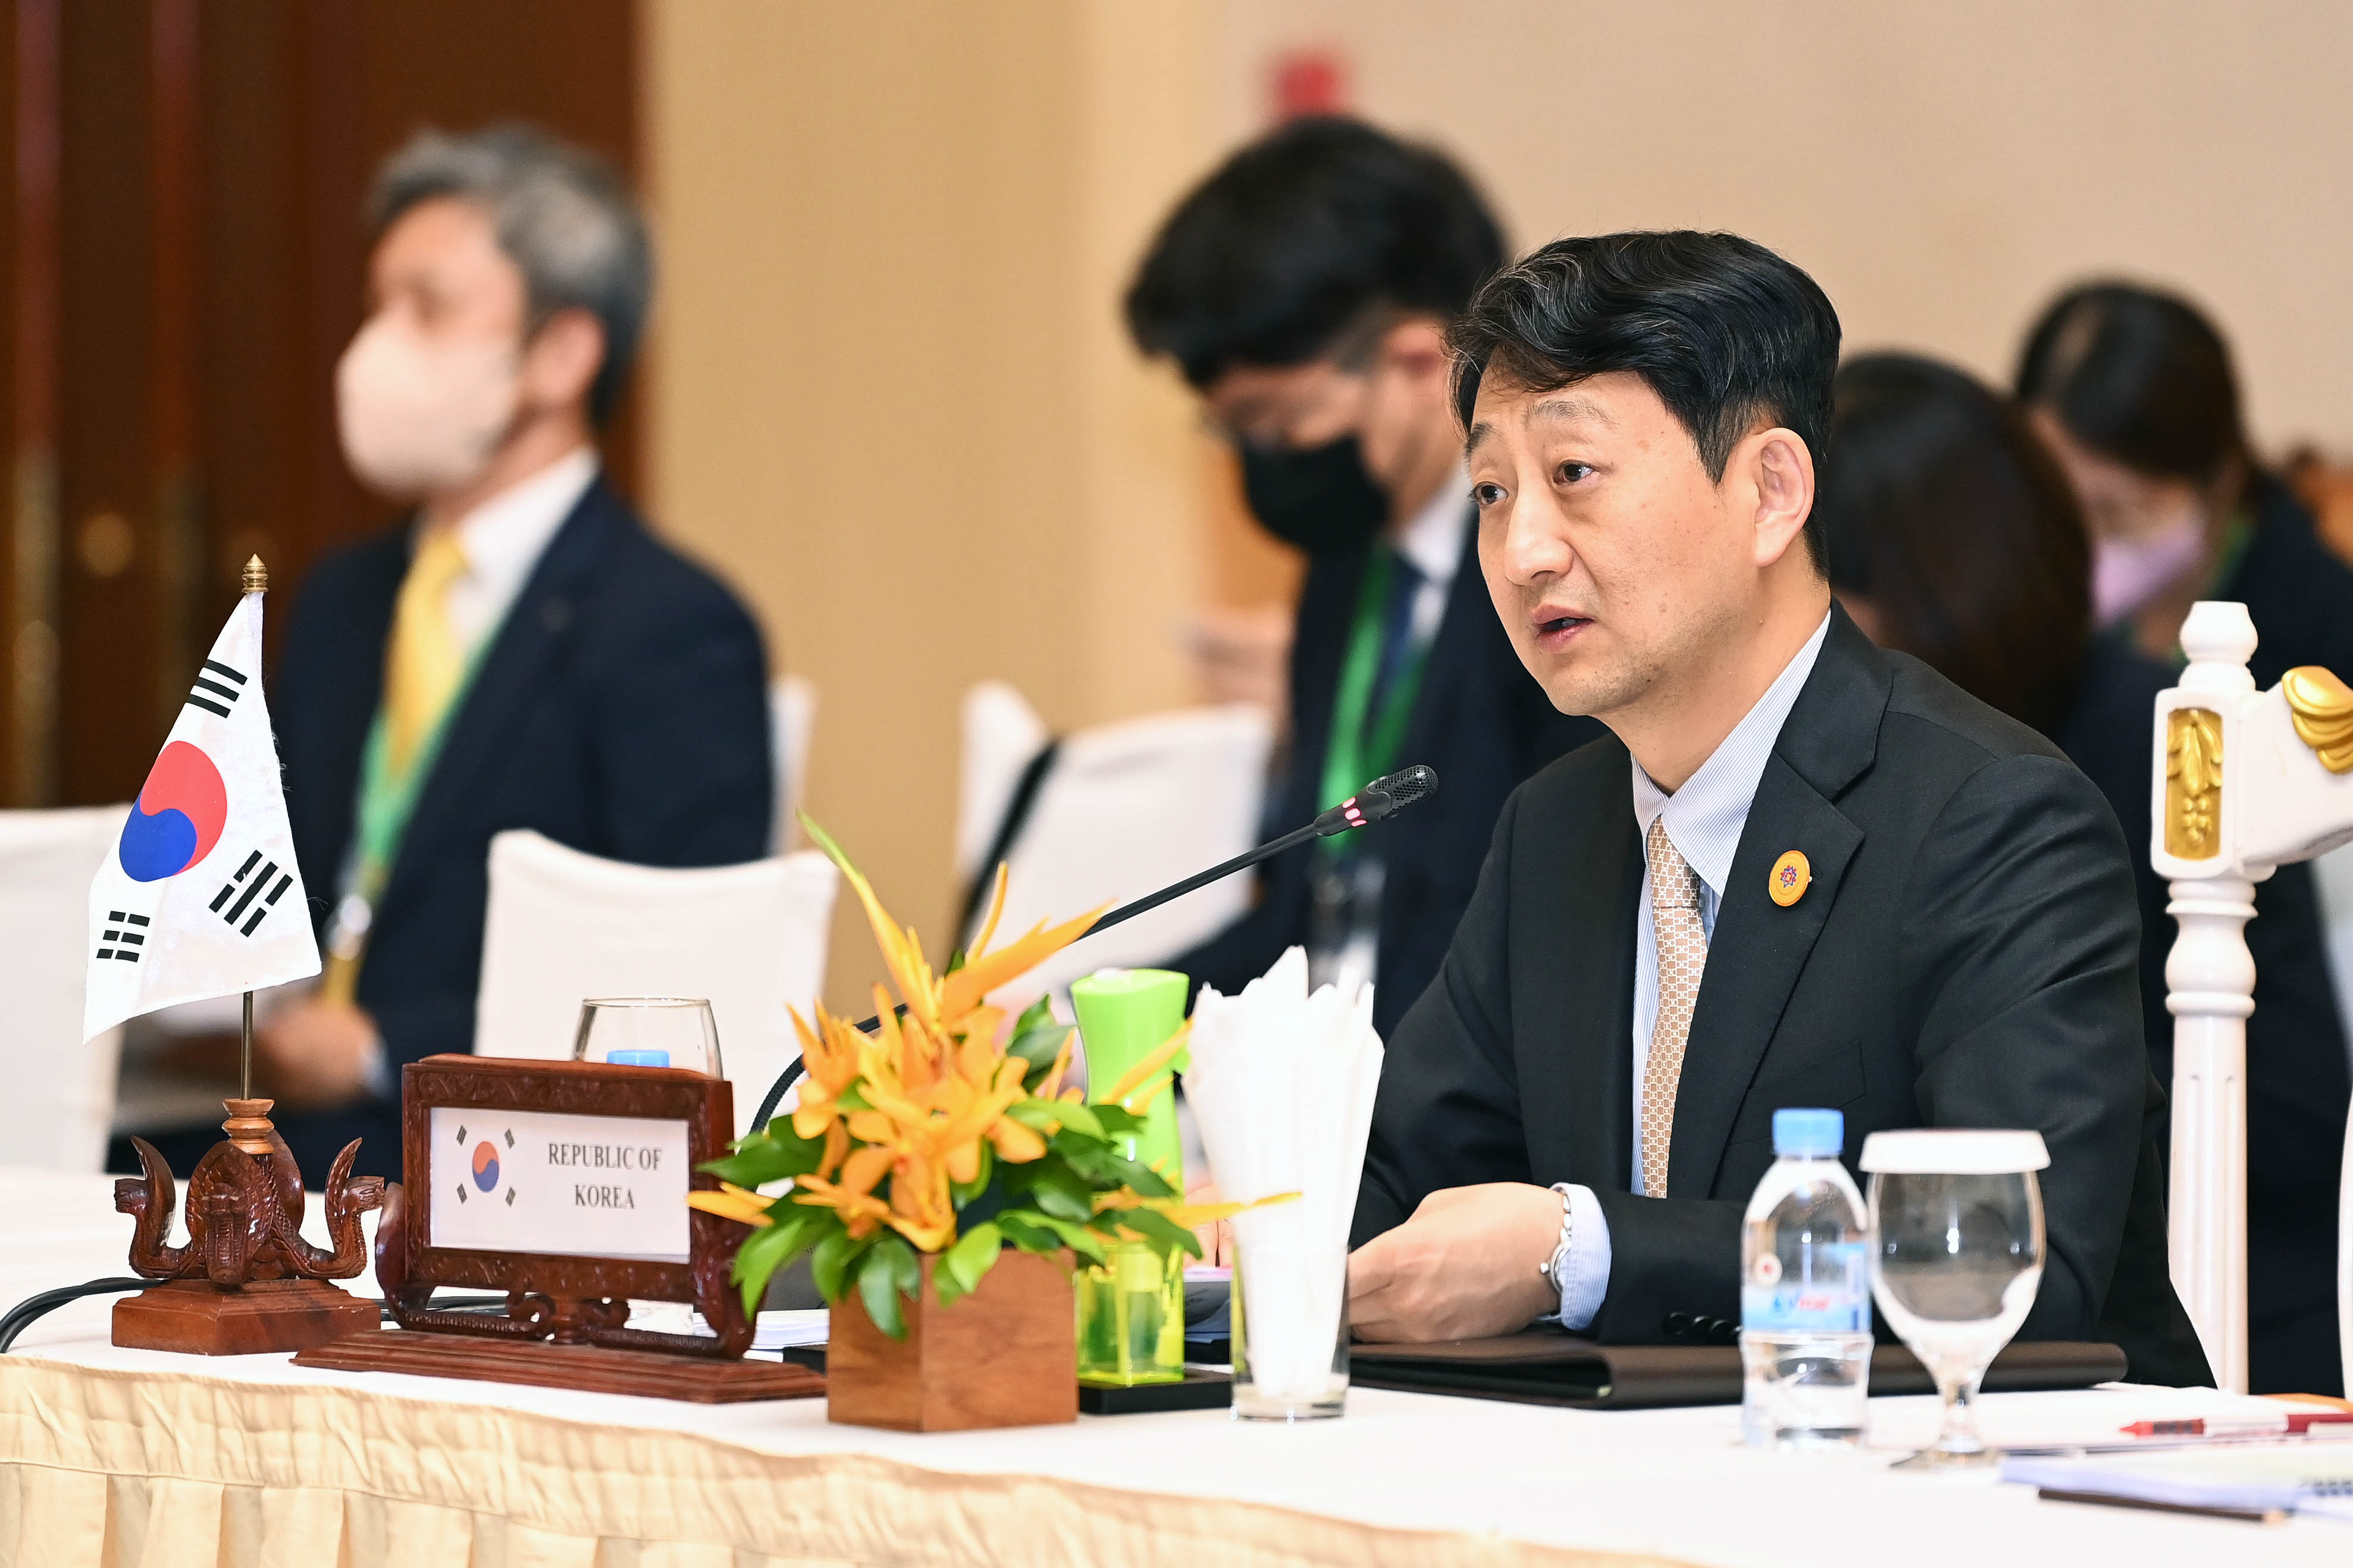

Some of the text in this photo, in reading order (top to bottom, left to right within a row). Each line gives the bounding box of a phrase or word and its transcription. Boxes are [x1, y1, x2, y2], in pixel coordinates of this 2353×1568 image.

[548, 1143, 662, 1171] REPUBLIC OF
[574, 1184, 635, 1210] KOREA
